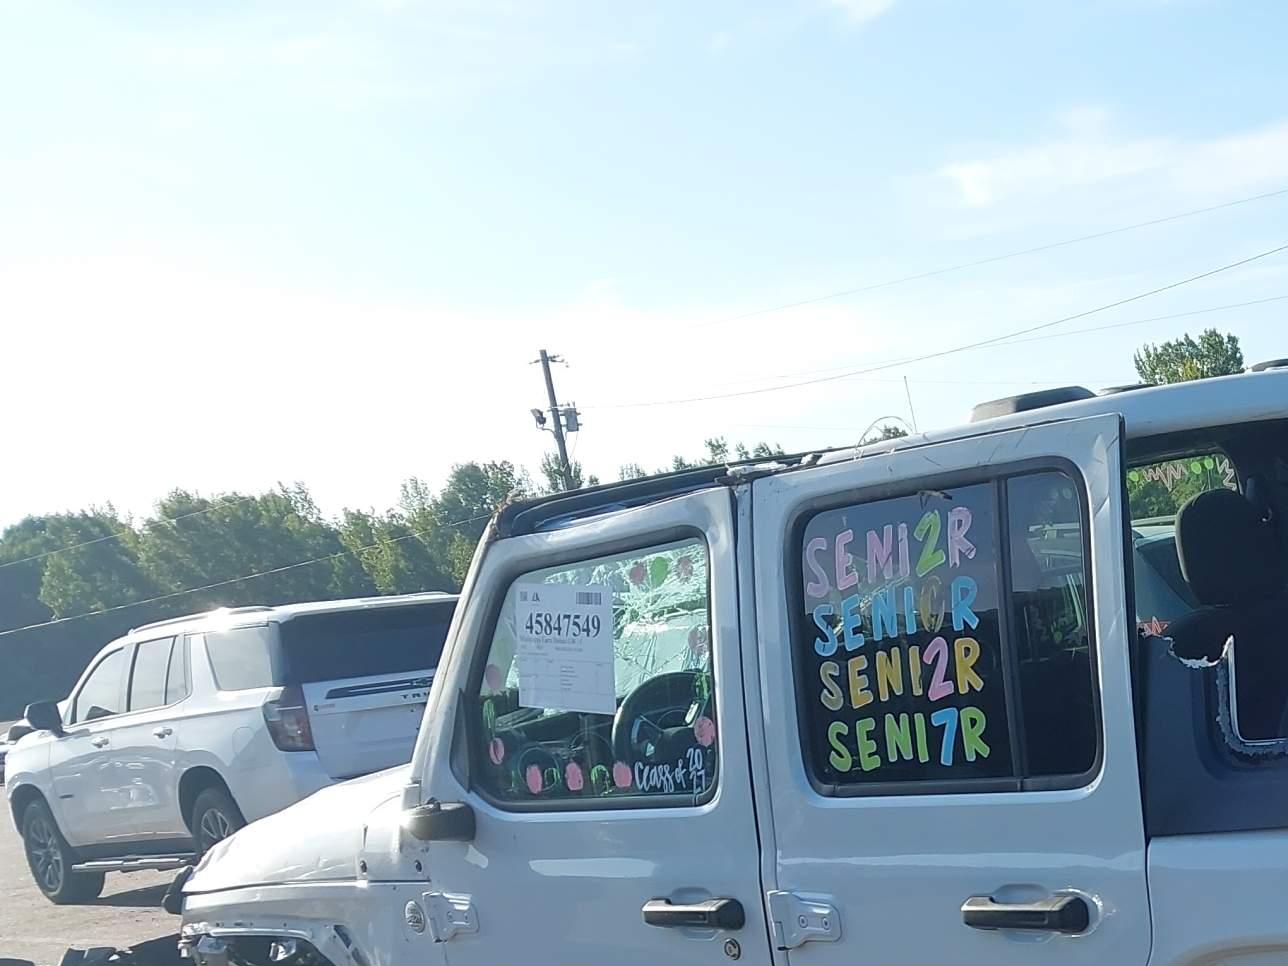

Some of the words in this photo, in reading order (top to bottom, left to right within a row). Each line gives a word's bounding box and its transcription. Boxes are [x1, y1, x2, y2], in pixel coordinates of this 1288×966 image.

[805, 507, 977, 598] SENI2R
[525, 612, 601, 638] 45847549
[819, 636, 985, 711] SENI2R
[827, 706, 991, 772] SENI7R
[674, 758, 687, 789] of
